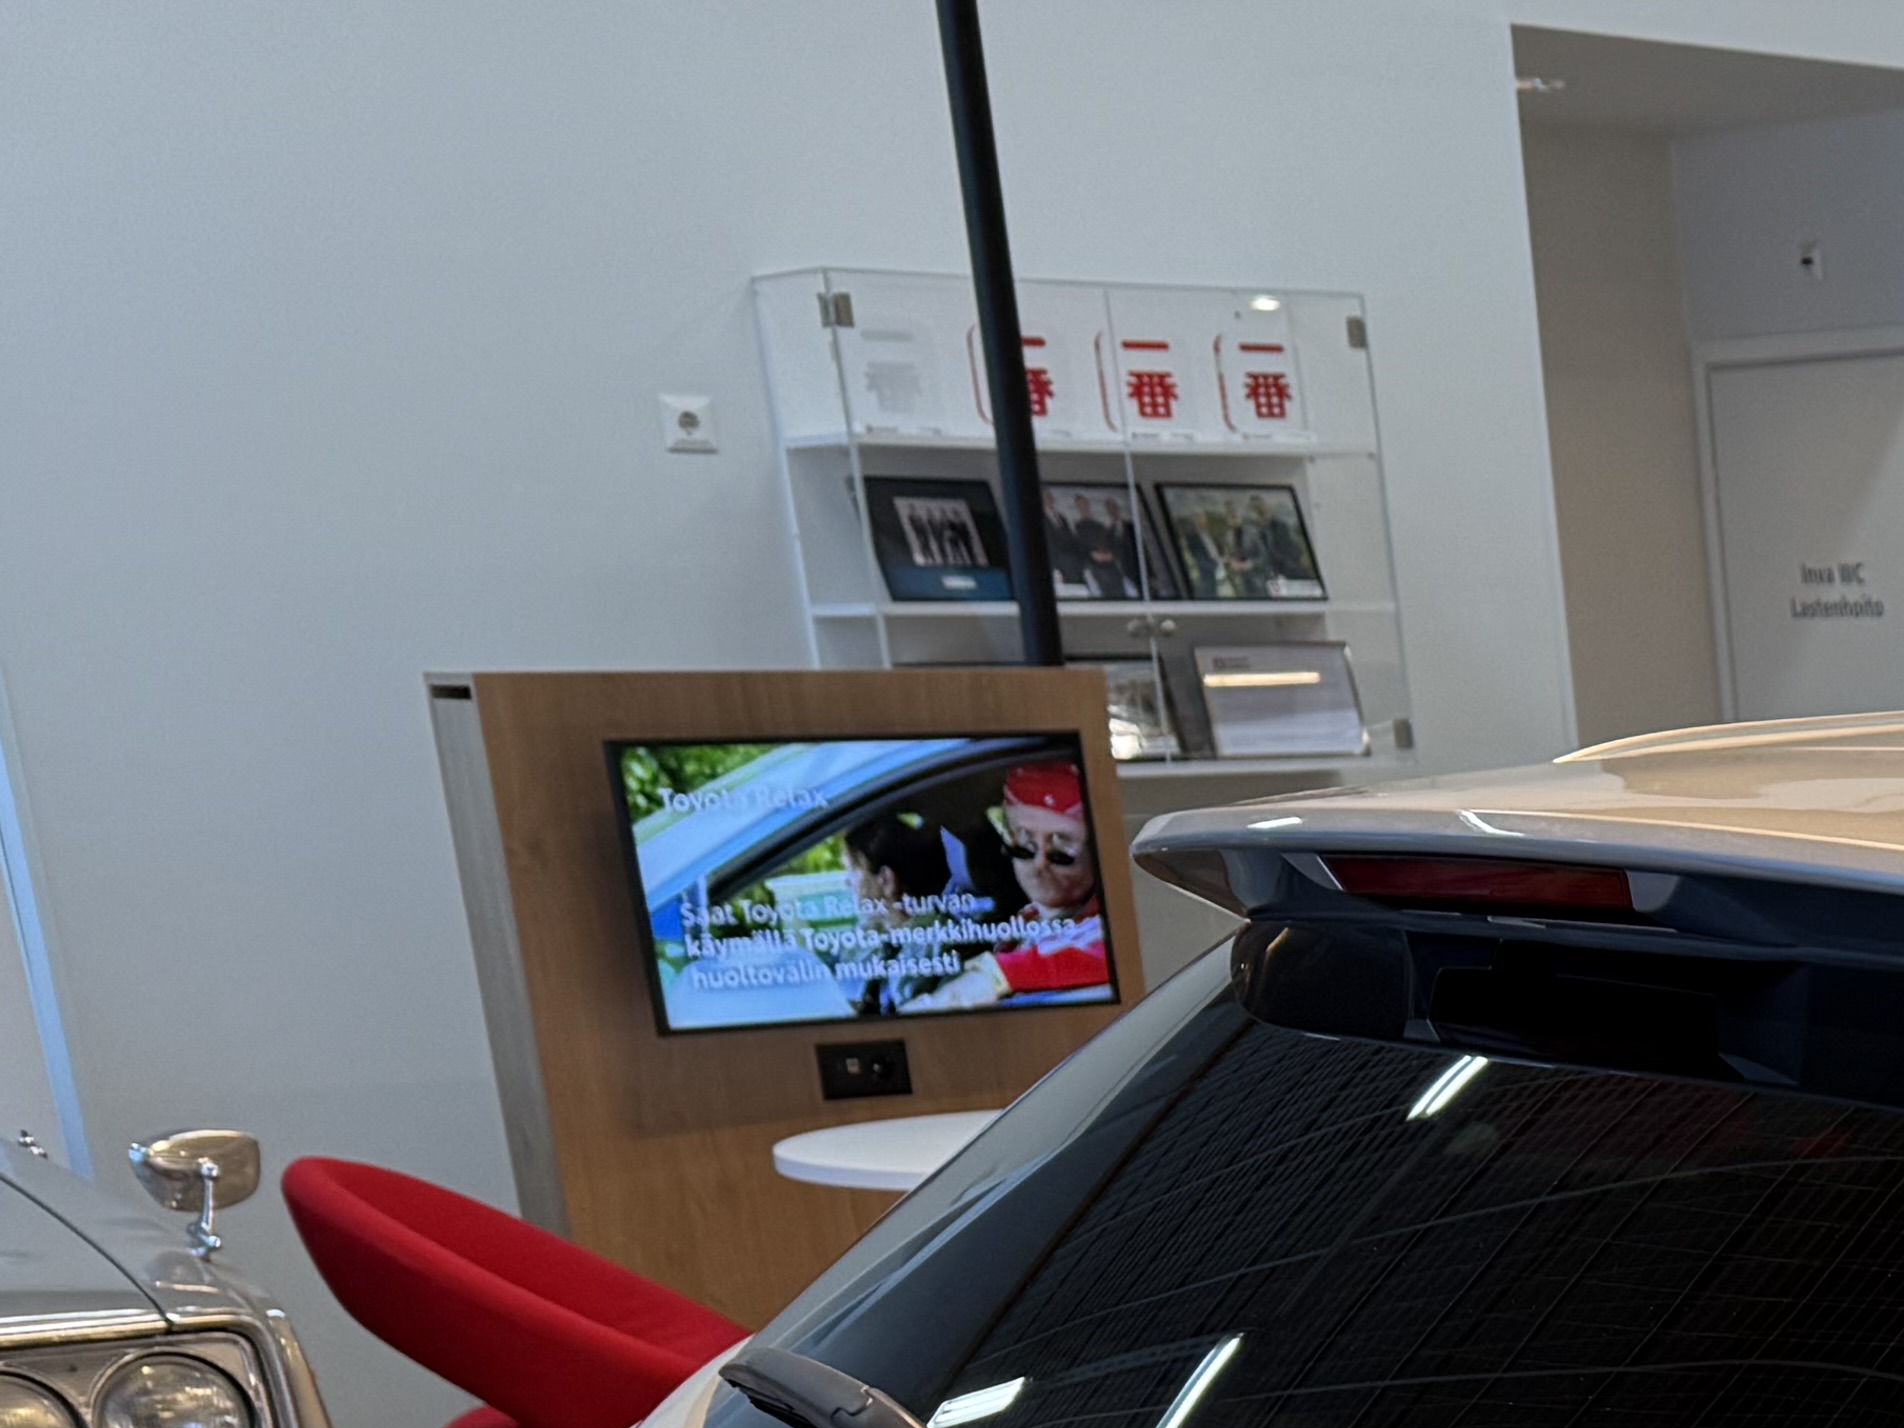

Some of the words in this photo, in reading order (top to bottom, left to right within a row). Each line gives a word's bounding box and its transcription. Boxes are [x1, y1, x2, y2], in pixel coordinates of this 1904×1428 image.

[1800, 562, 1836, 584] Inva
[1839, 561, 1866, 586] WC
[1789, 594, 1885, 619] Lastenhoito
[657, 786, 746, 813] Toyota
[754, 783, 829, 810] Relax
[680, 901, 735, 928] Saat
[741, 896, 822, 928] Toyota
[825, 894, 889, 918] Relax
[684, 925, 797, 959] käymällä
[802, 913, 1076, 954] Toyota-merkkihuollossa
[692, 957, 831, 989] huoltovälin
[834, 950, 962, 980] mukaisesti
